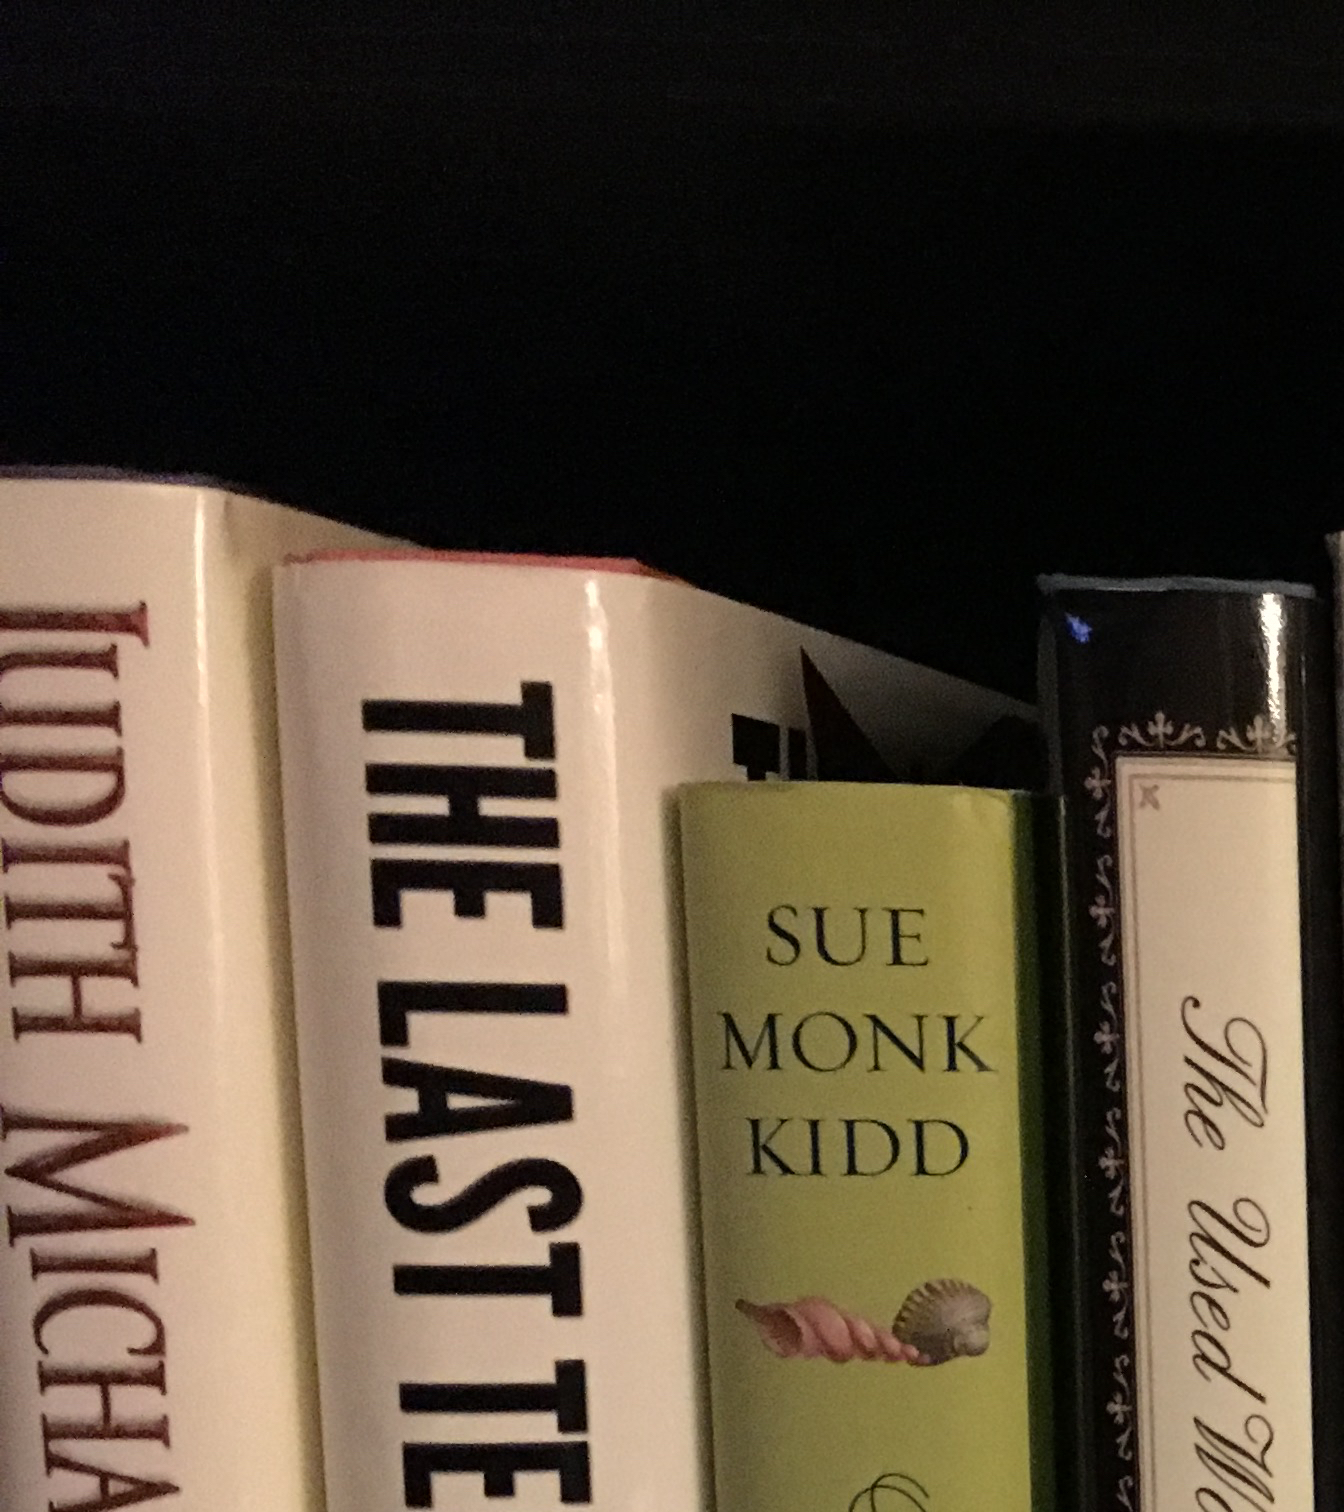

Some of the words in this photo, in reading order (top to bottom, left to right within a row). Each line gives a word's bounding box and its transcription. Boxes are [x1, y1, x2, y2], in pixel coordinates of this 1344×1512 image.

[0, 600, 151, 1043] JUDITH
[362, 681, 565, 929] THE
[765, 905, 929, 967] SUE
[716, 1011, 998, 1074] MONK
[1181, 996, 1268, 1151] The
[377, 981, 585, 1317] LAST
[745, 1116, 971, 1178] KIDD
[1187, 1197, 1272, 1405] Used
